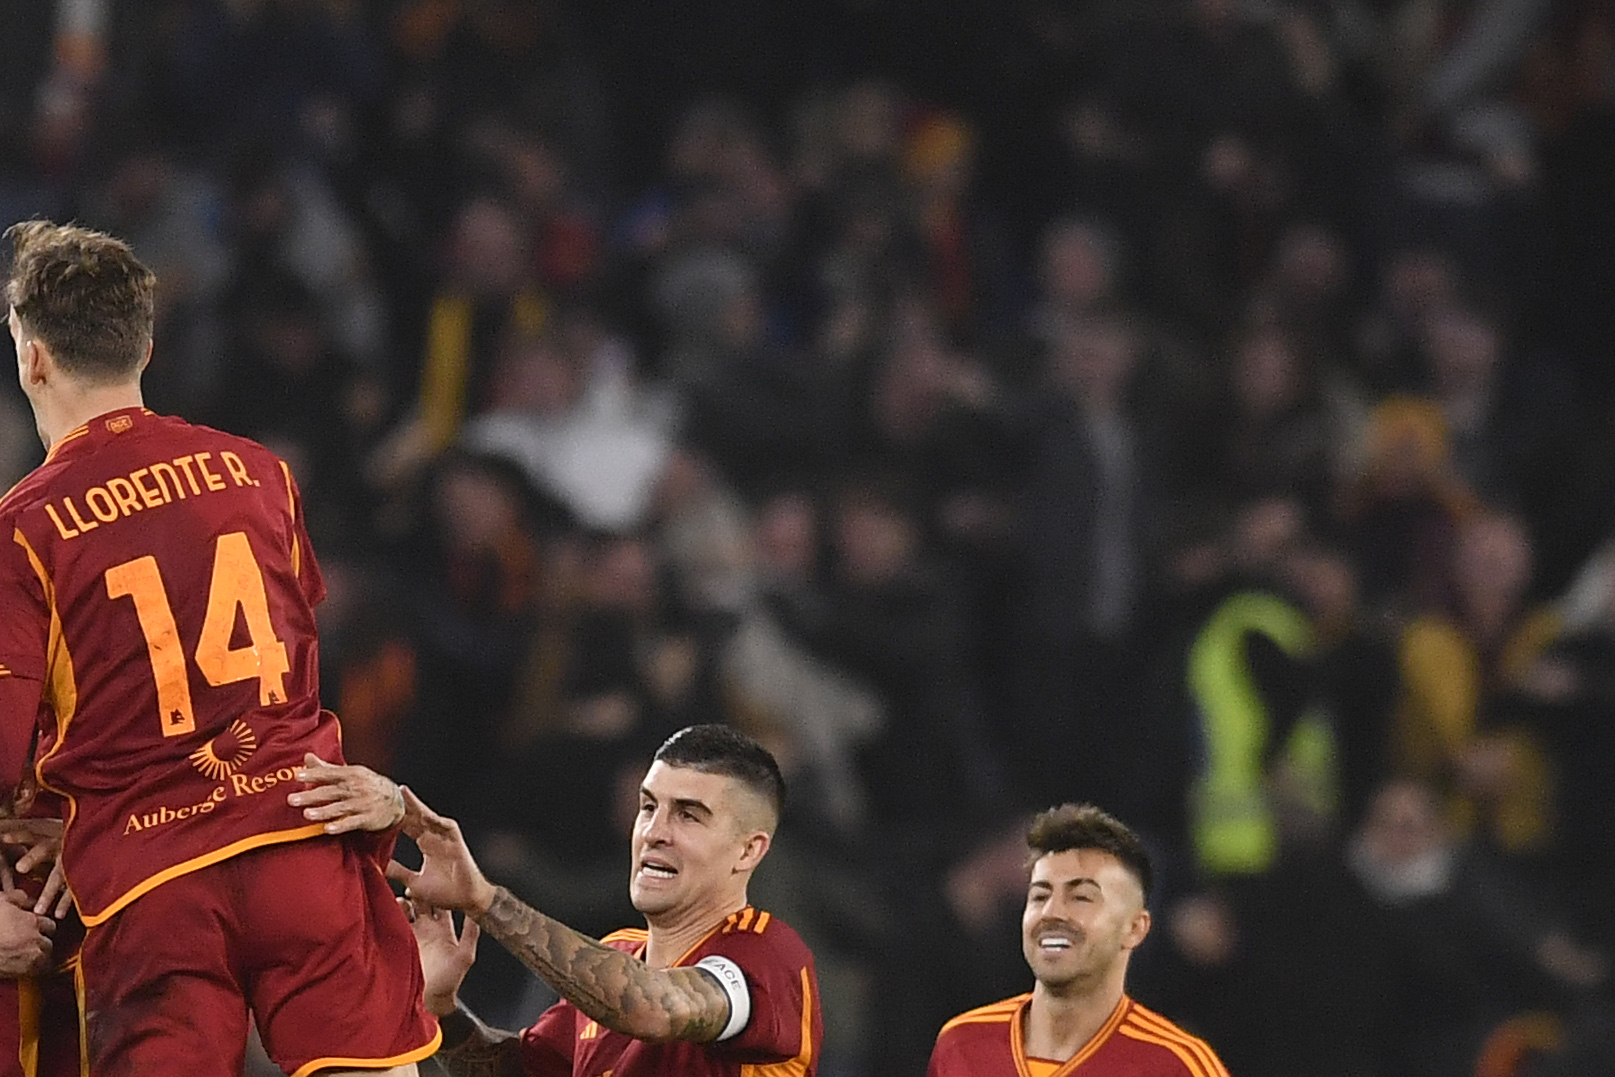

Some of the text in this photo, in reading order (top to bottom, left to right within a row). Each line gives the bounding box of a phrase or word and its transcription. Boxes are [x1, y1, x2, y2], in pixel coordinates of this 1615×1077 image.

[44, 451, 260, 540] LLORENTE R.
[105, 531, 289, 737] 14
[123, 765, 307, 836] Auberge Resor
